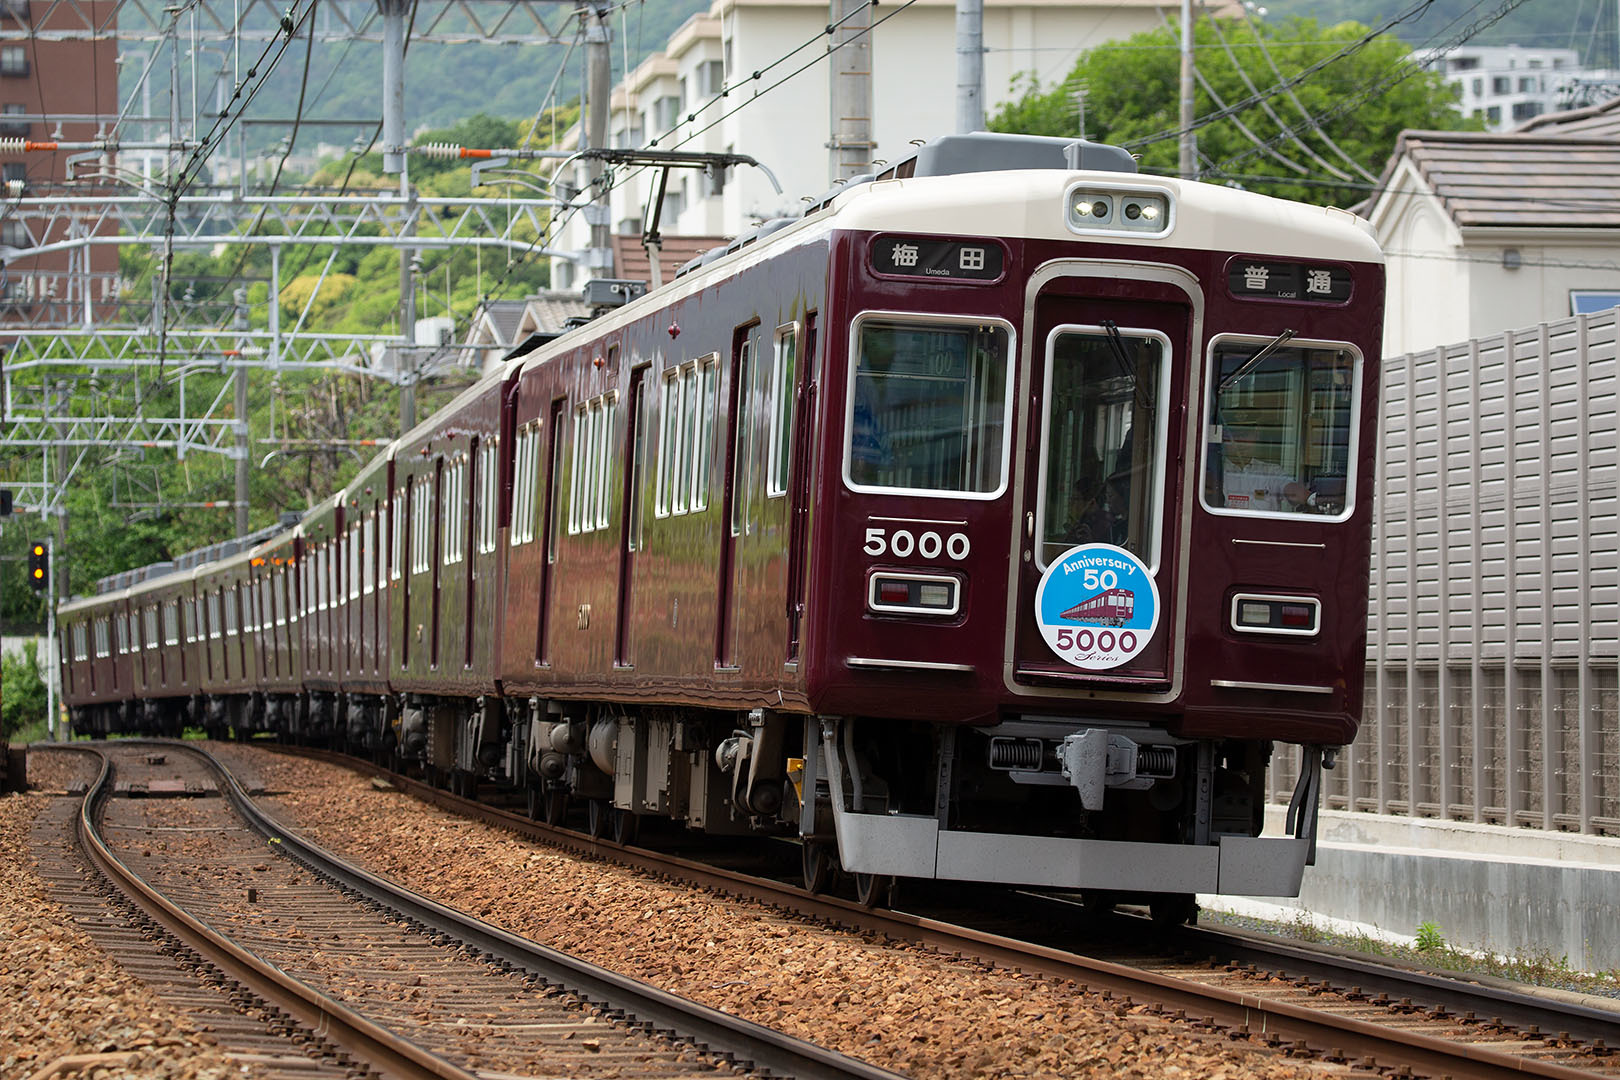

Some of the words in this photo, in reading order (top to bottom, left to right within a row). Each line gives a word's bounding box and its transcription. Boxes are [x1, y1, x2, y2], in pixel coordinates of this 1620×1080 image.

[891, 243, 985, 270] 梅田
[925, 267, 950, 276] Umeda
[1244, 265, 1332, 294] 普通
[1278, 290, 1297, 299] Local
[863, 528, 971, 561] 5000
[1062, 555, 1136, 576] Anniversary
[1083, 569, 1118, 591] 50
[1056, 629, 1137, 653] 5000
[1074, 651, 1119, 662] Series
